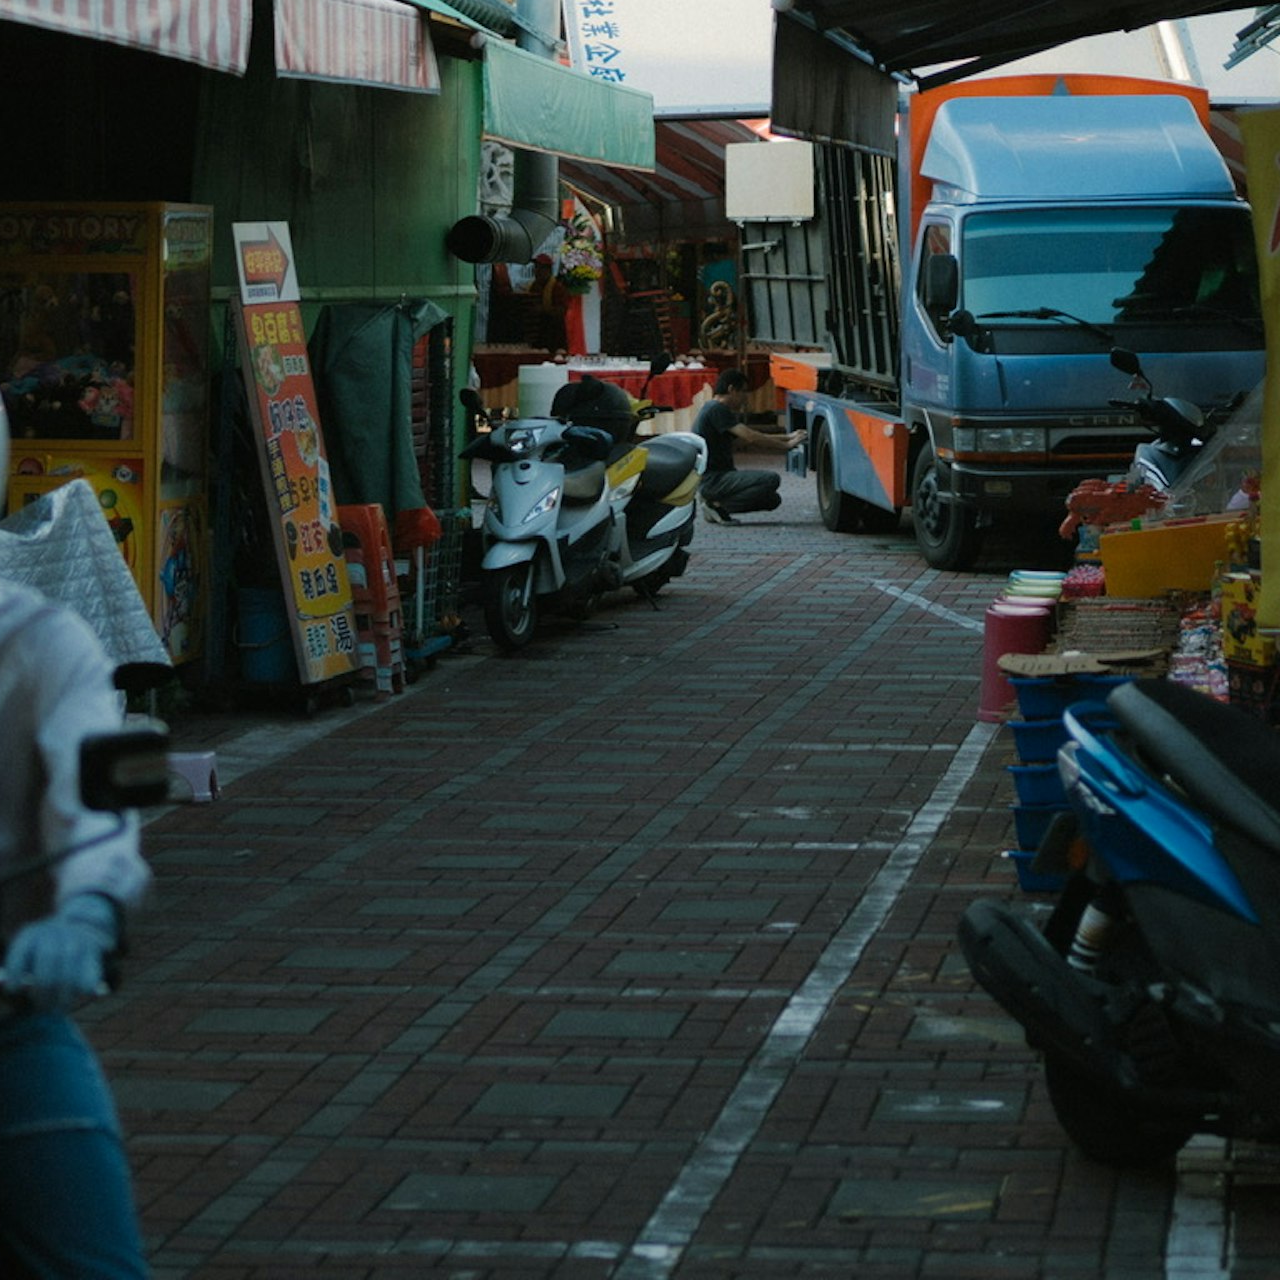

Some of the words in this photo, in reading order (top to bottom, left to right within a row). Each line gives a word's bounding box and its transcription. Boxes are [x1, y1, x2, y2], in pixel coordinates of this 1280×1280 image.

[46, 215, 140, 240] STORY
[251, 311, 291, 345] 臭豆腐
